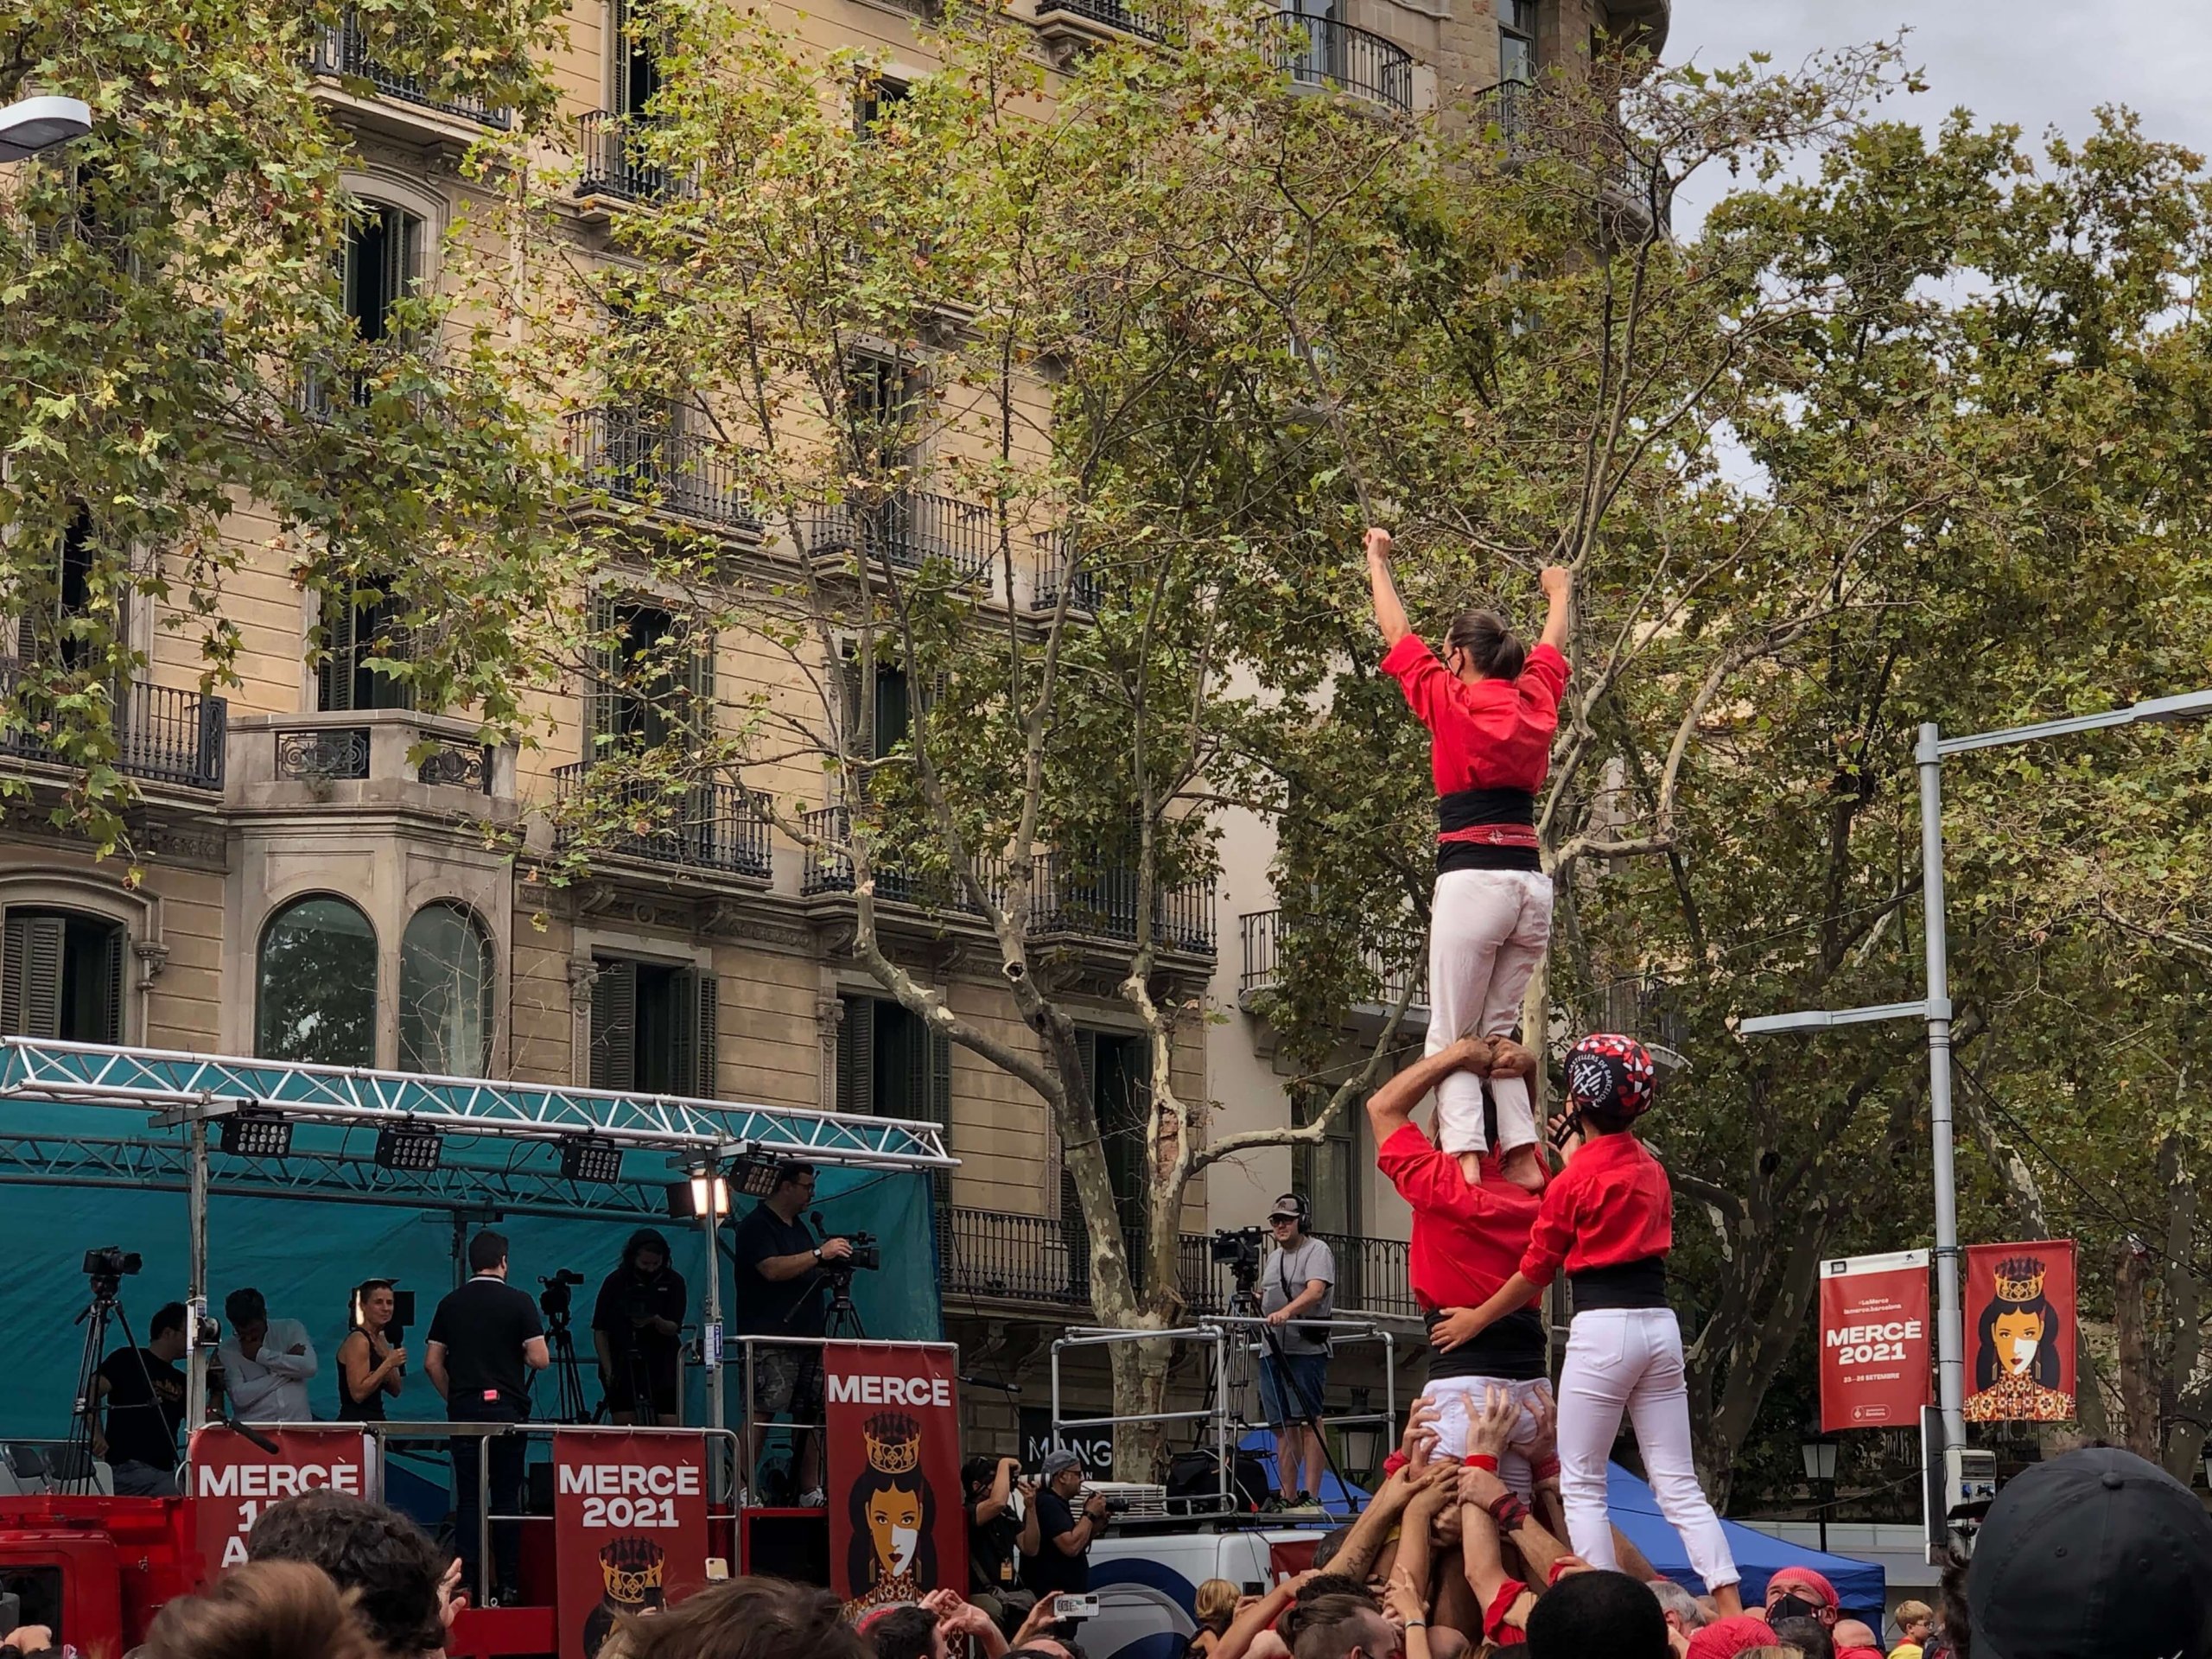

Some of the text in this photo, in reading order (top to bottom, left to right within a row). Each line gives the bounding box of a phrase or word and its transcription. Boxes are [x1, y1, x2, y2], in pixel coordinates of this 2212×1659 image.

[1598, 1059, 1608, 1069] DE
[1826, 1316, 1923, 1347] MERCÈ
[1838, 1342, 1906, 1365] 2021
[828, 1371, 951, 1407] MERCÈ
[1028, 1435, 1113, 1467] MNG
[199, 1456, 359, 1497] MERCÈ
[559, 1459, 700, 1496] MERCÈ
[582, 1497, 680, 1529] 2021
